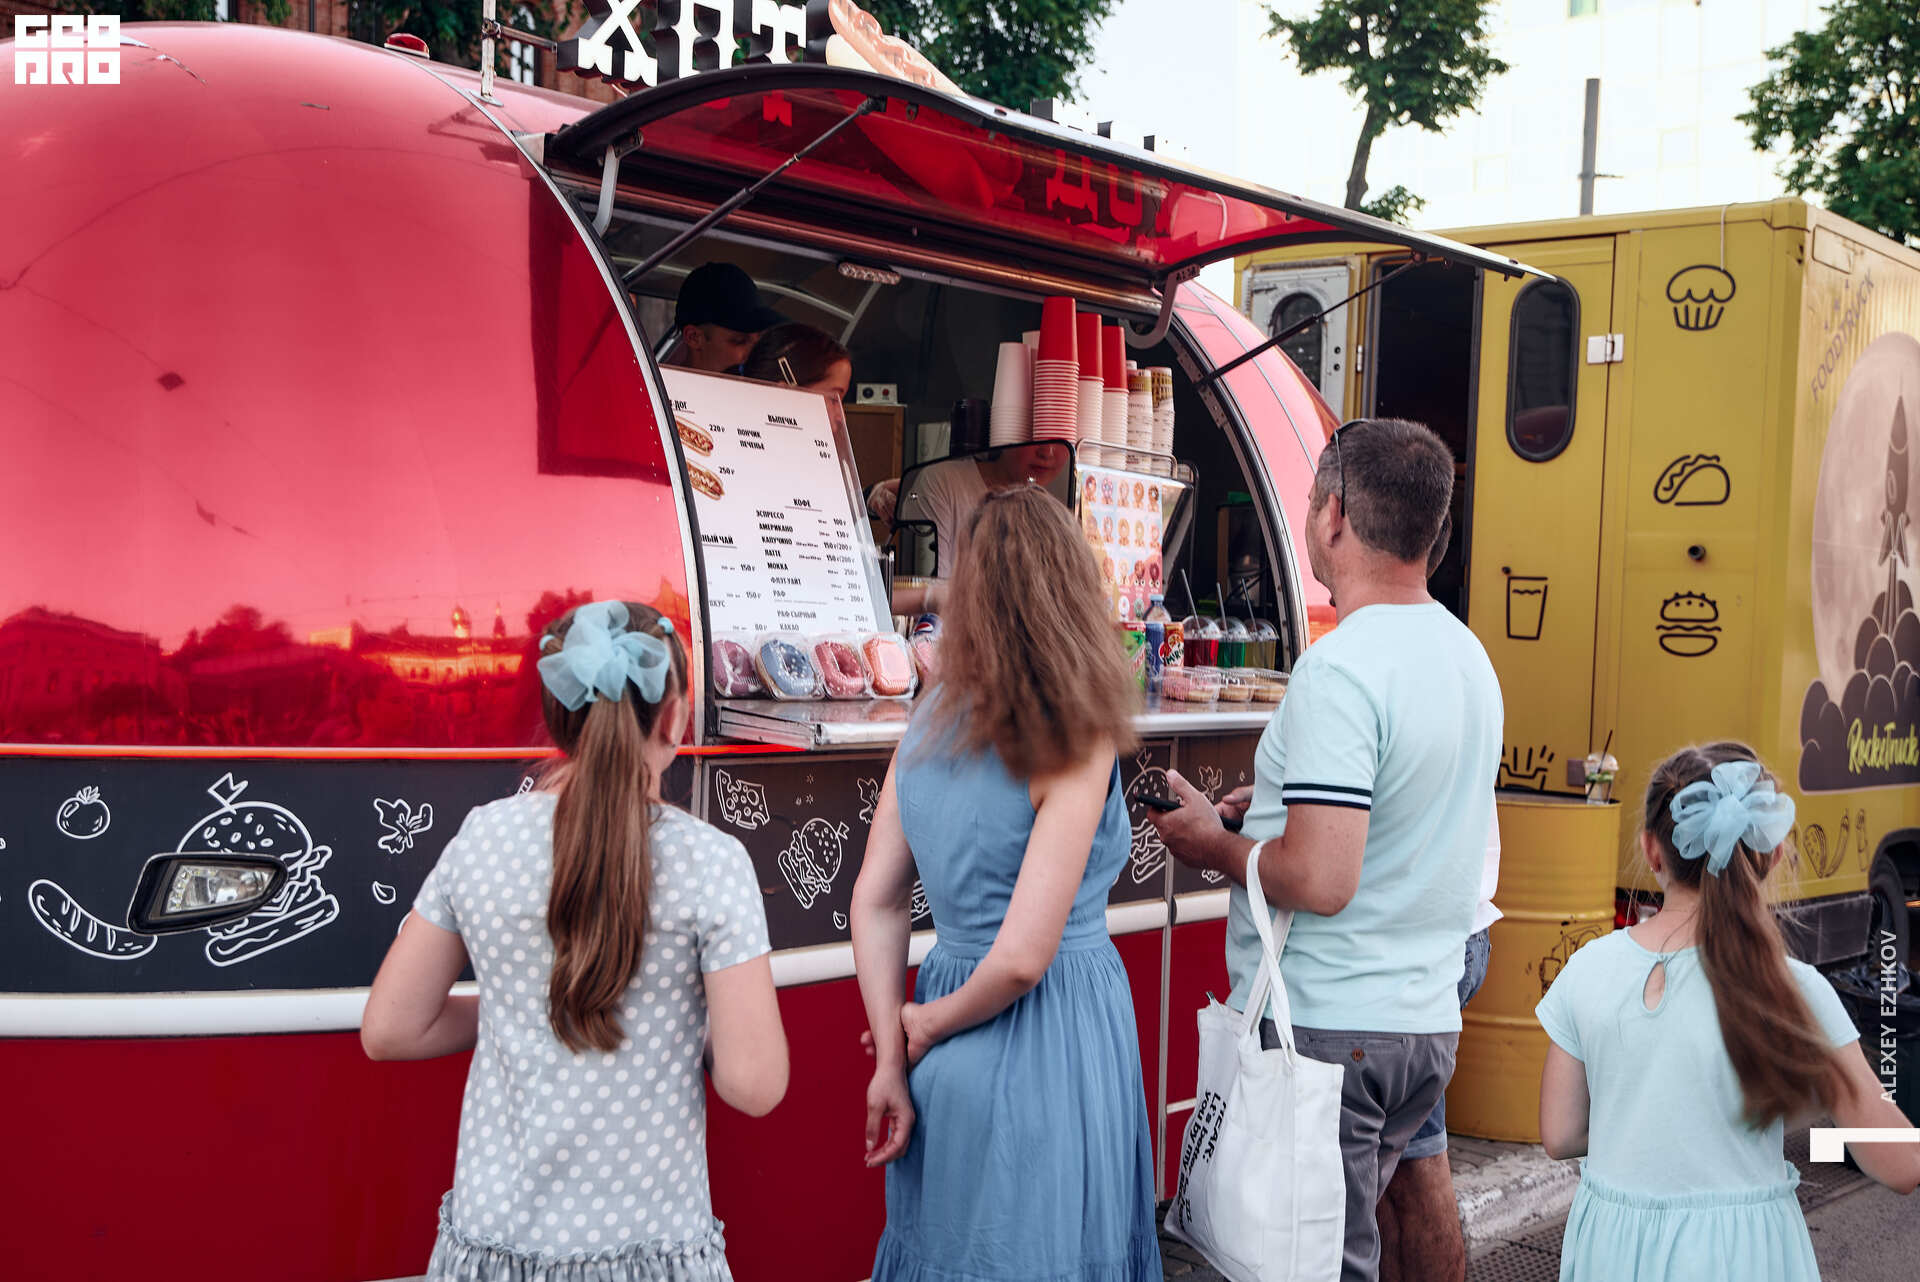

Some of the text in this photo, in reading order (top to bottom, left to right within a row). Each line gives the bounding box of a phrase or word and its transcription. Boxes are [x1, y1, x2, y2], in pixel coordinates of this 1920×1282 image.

[1810, 268, 1875, 405] FOODTRUCK
[767, 415, 798, 426] ВЫПЕЧКА
[709, 424, 720, 433] 220
[740, 440, 765, 450] ПЕЧЕНЬЕ
[793, 498, 811, 508] КОФЕ
[756, 510, 785, 519] ЭСПРЕССО
[759, 523, 793, 533] АМЕРИКАНО
[719, 534, 734, 545] ЧАЙ
[761, 536, 793, 545] КАПУЧИНО
[764, 549, 782, 558] ЛАТТЕ
[767, 562, 789, 570] МОККА
[1183, 1089, 1212, 1171] you by my
